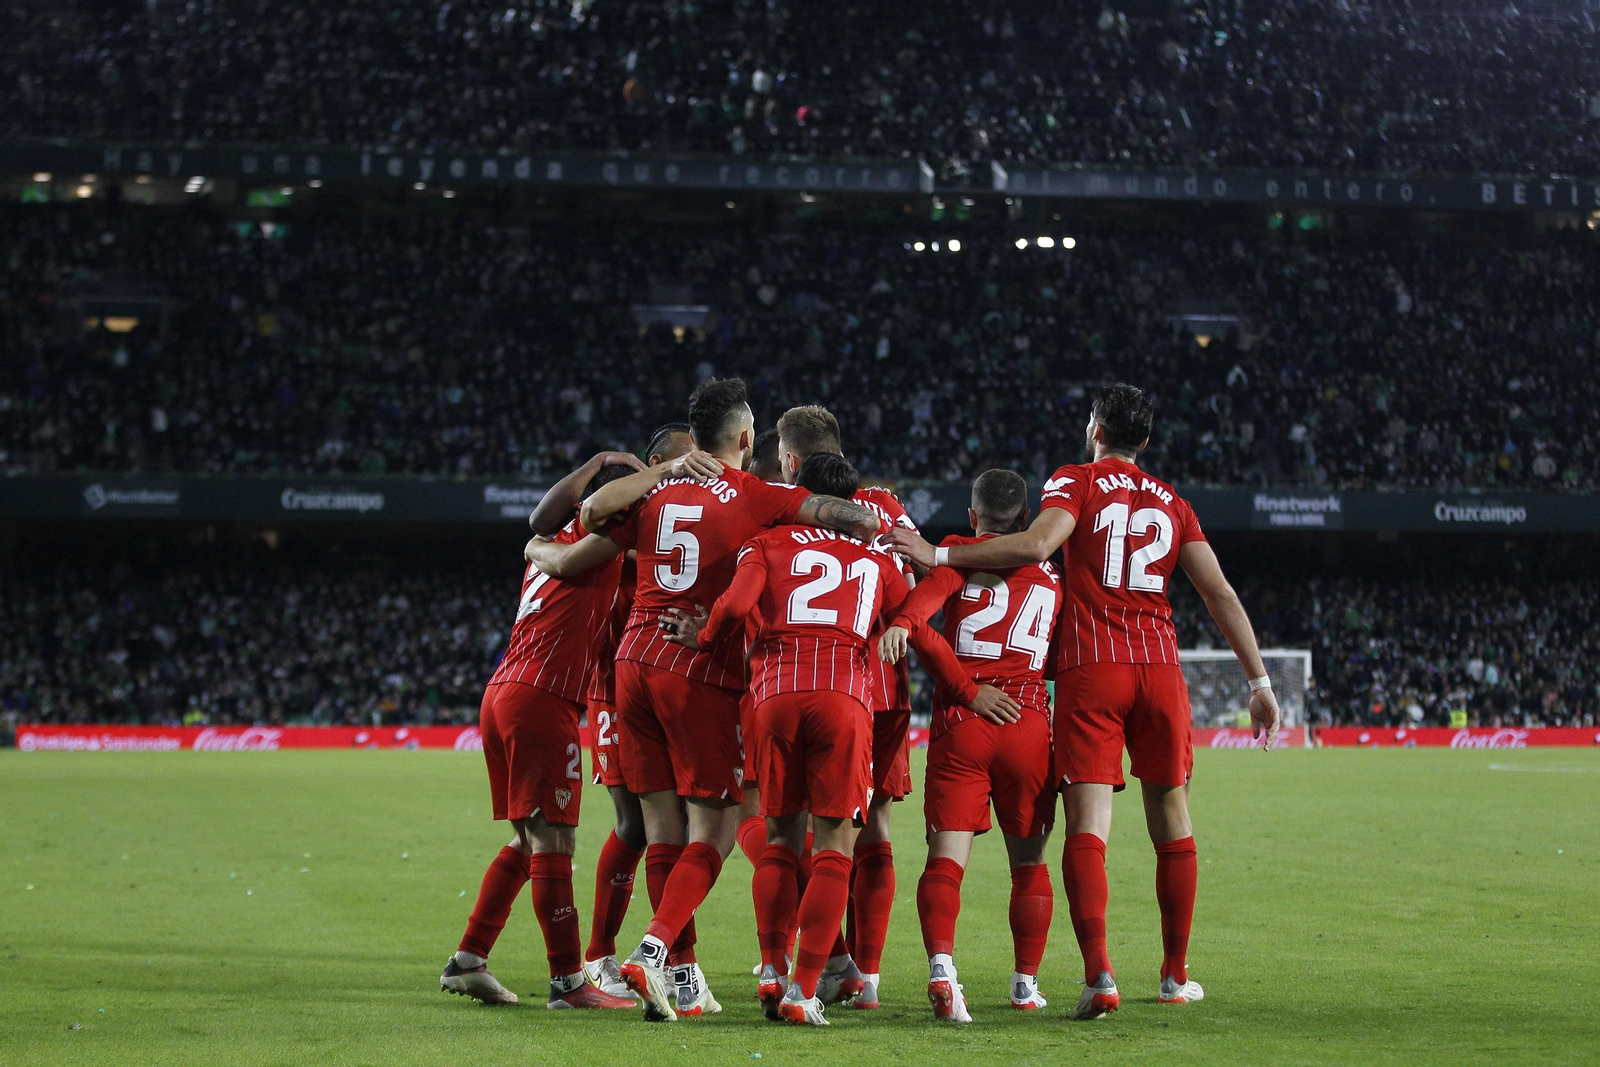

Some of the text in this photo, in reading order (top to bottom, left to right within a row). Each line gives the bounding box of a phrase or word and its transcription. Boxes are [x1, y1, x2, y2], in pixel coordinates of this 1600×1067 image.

[104, 151, 183, 176] Hay
[242, 154, 321, 174] una
[361, 154, 562, 181] leyenda
[602, 162, 680, 184] que
[718, 164, 901, 189] recorre
[1089, 174, 1228, 197] mundo
[1095, 473, 1174, 505] RAFA MIR
[1253, 494, 1342, 513] finetwork
[1434, 501, 1527, 525] Cruzcampo
[655, 503, 704, 592] 5
[1093, 502, 1174, 593] 12
[787, 549, 880, 639] 21
[955, 572, 1056, 672] 24
[566, 742, 580, 779] 2
[554, 906, 572, 915] SFC
